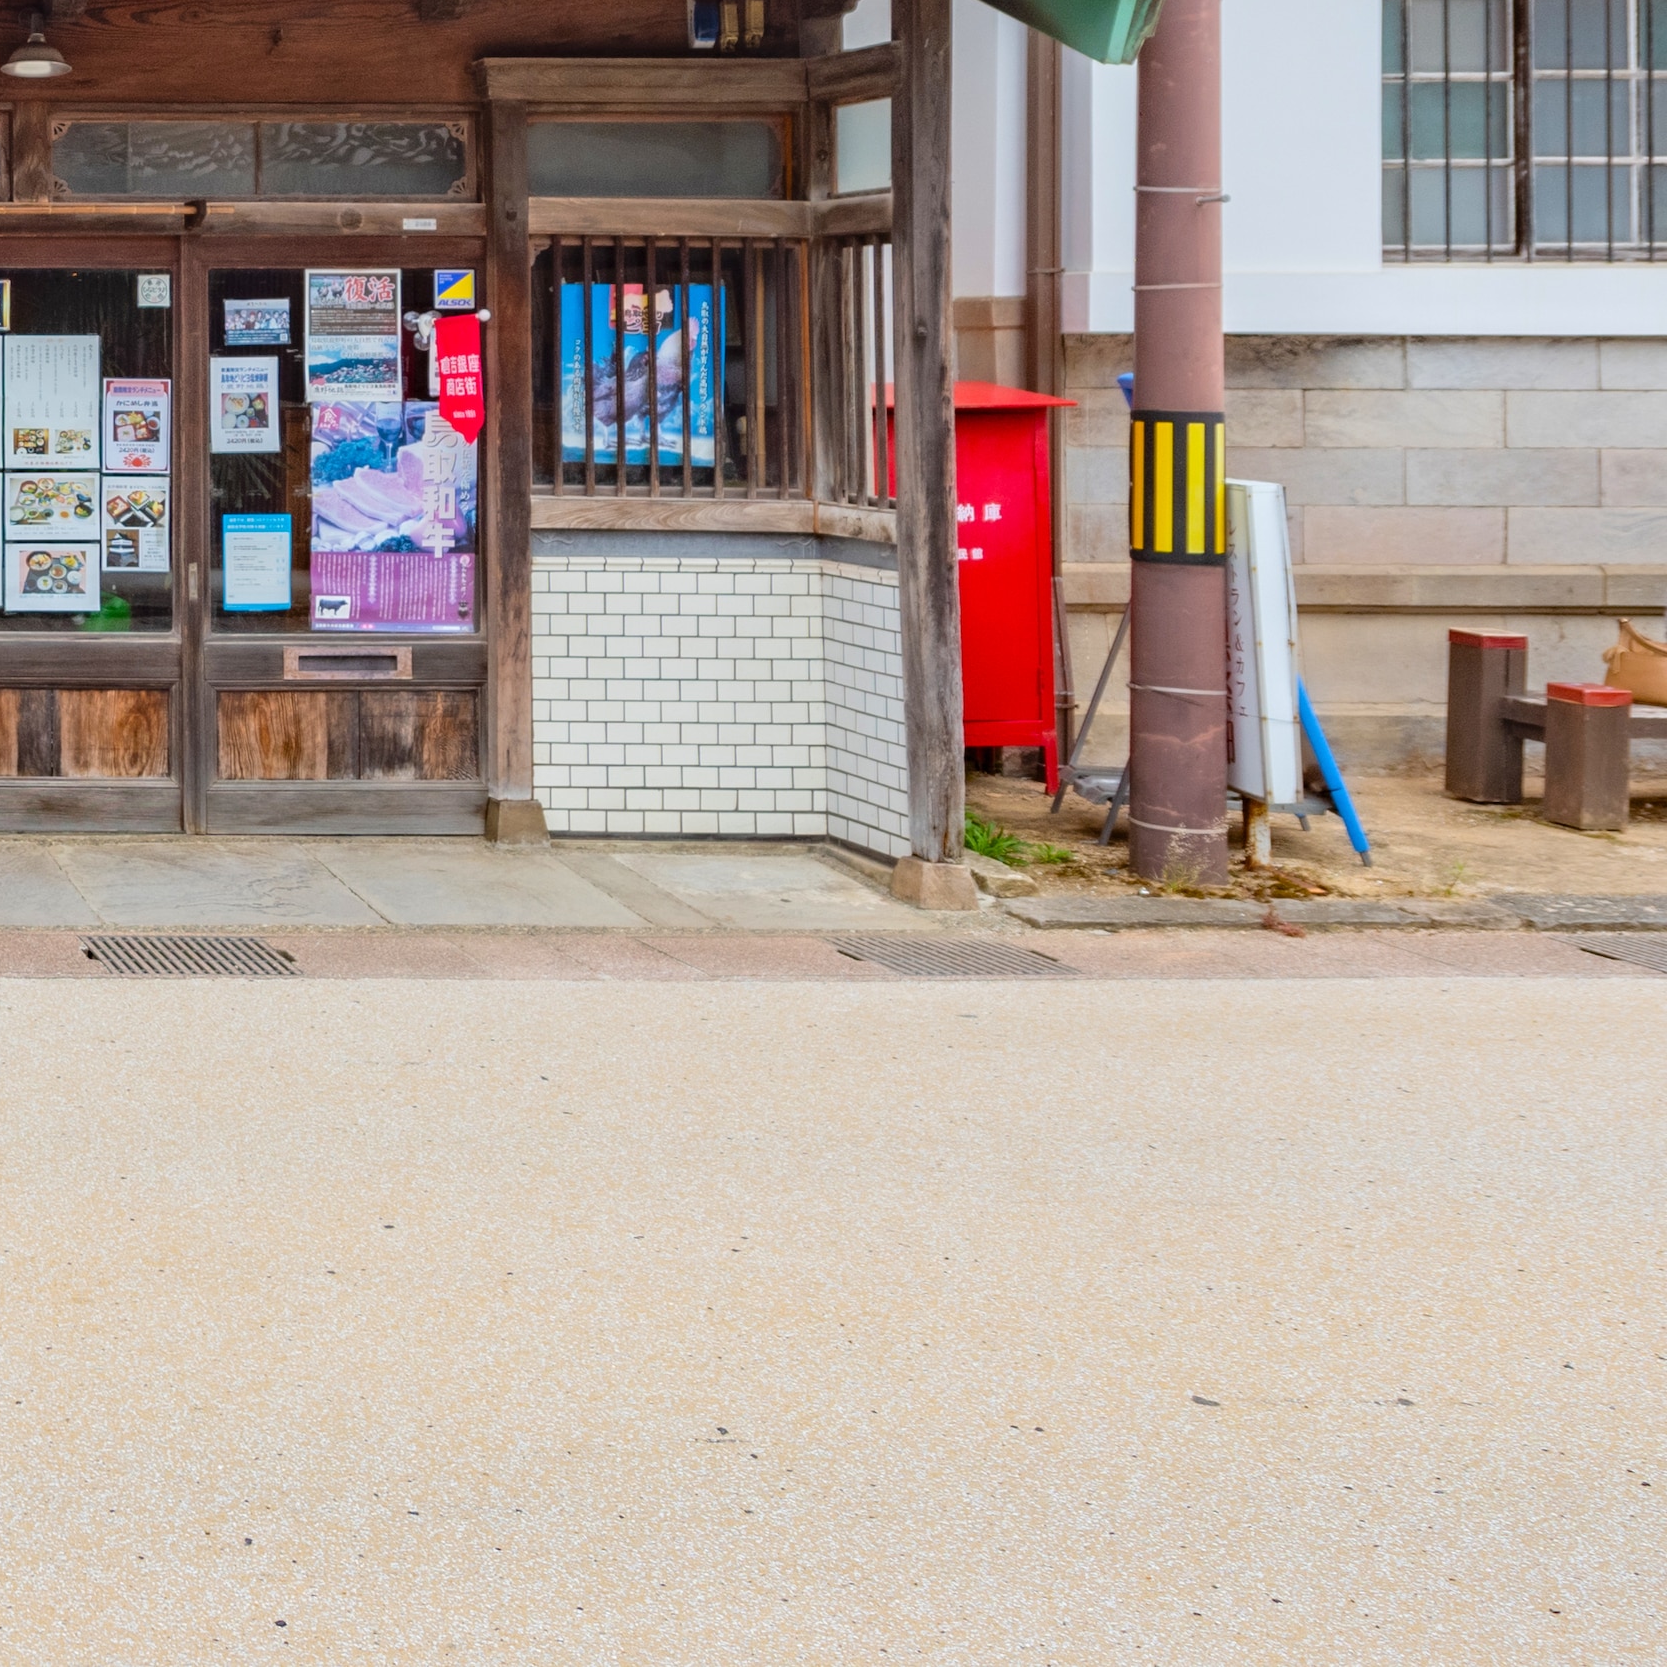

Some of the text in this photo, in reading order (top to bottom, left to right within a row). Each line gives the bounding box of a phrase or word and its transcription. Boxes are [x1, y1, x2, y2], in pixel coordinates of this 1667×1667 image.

[344, 276, 396, 303] 復活
[437, 299, 471, 307] ALSOK
[440, 354, 480, 375] 倉吉銀座
[446, 377, 478, 396] 商店街
[422, 409, 459, 559] 鳥取和牛
